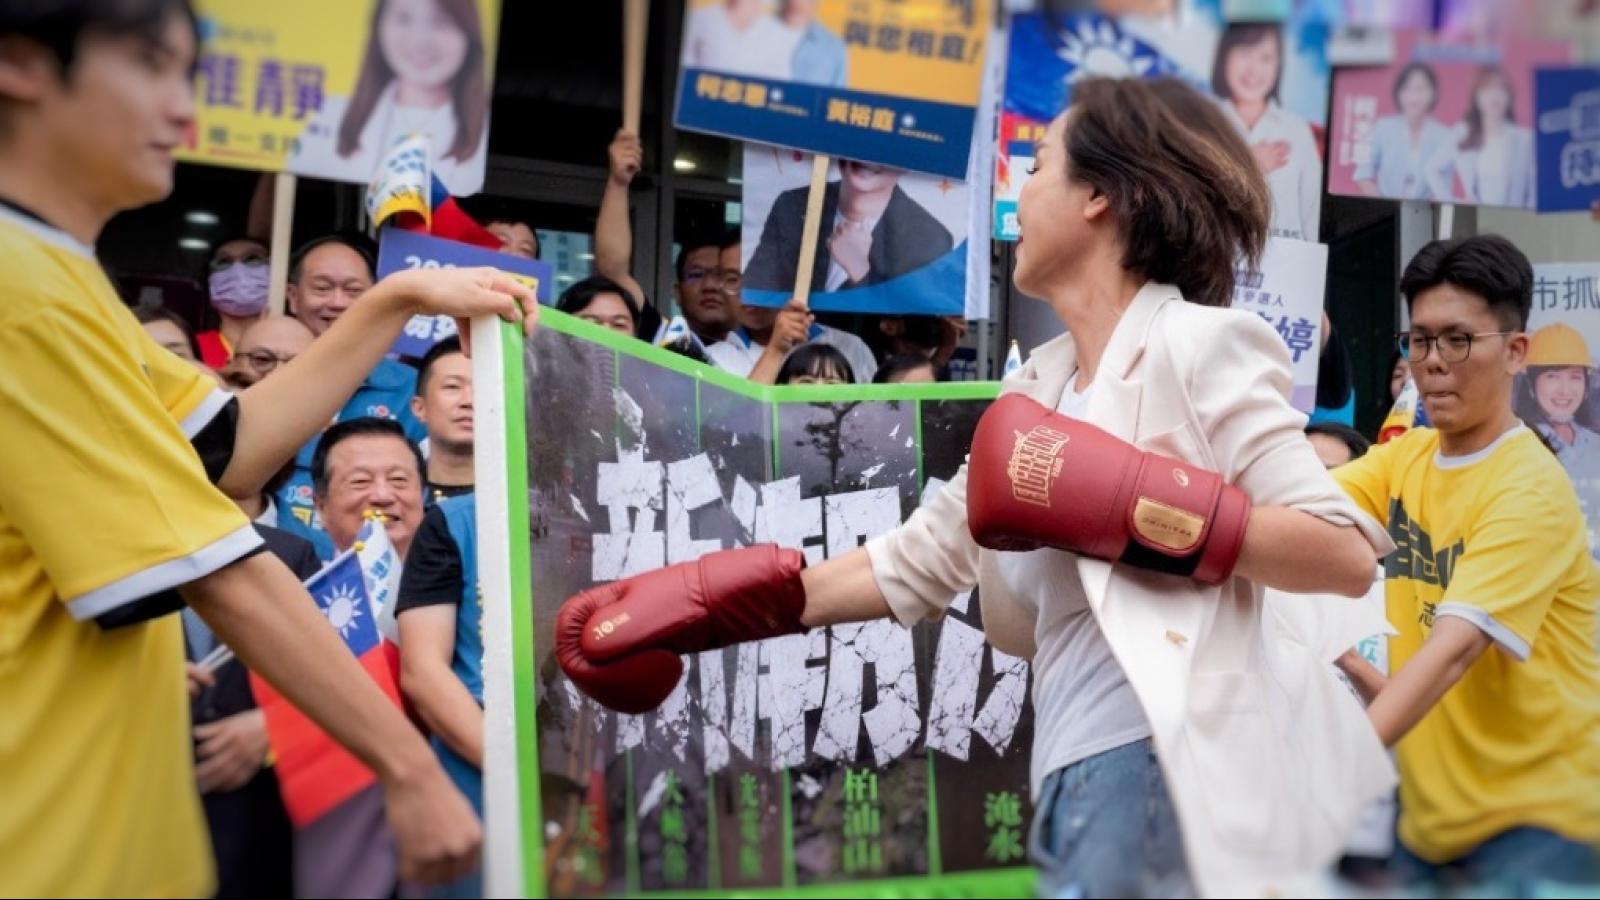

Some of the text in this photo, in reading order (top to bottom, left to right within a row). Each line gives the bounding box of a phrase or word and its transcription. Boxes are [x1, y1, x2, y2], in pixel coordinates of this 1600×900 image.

[1533, 275, 1600, 311] 市抓
[843, 767, 882, 874] 柏油山
[984, 790, 1024, 864] 淹水
